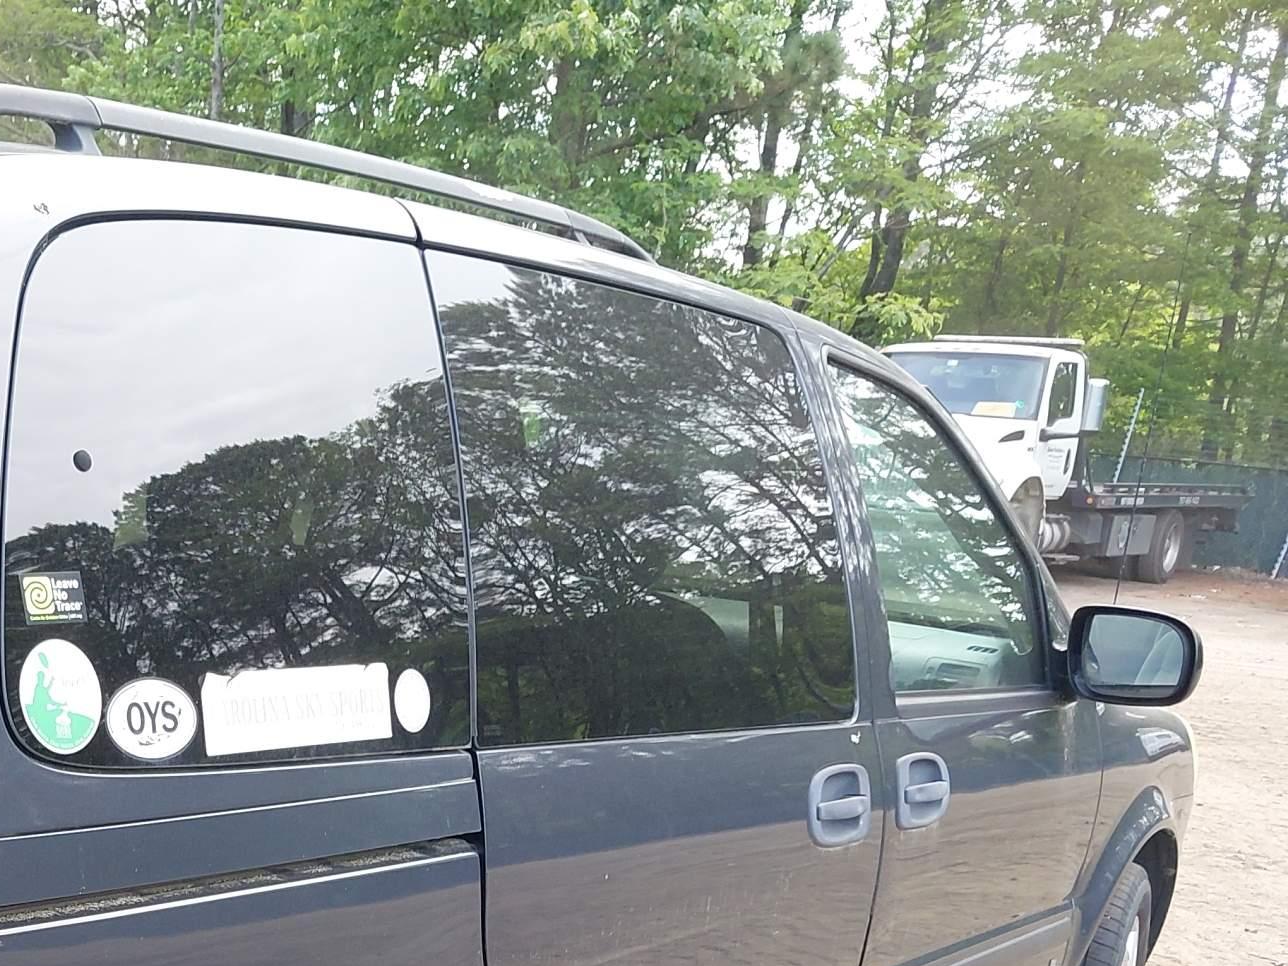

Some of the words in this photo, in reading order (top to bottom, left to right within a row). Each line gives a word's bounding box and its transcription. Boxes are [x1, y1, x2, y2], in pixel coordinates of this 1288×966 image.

[50, 577, 80, 589] Leave
[52, 589, 69, 601] No
[54, 600, 82, 612] Trace
[125, 699, 179, 736] OYS
